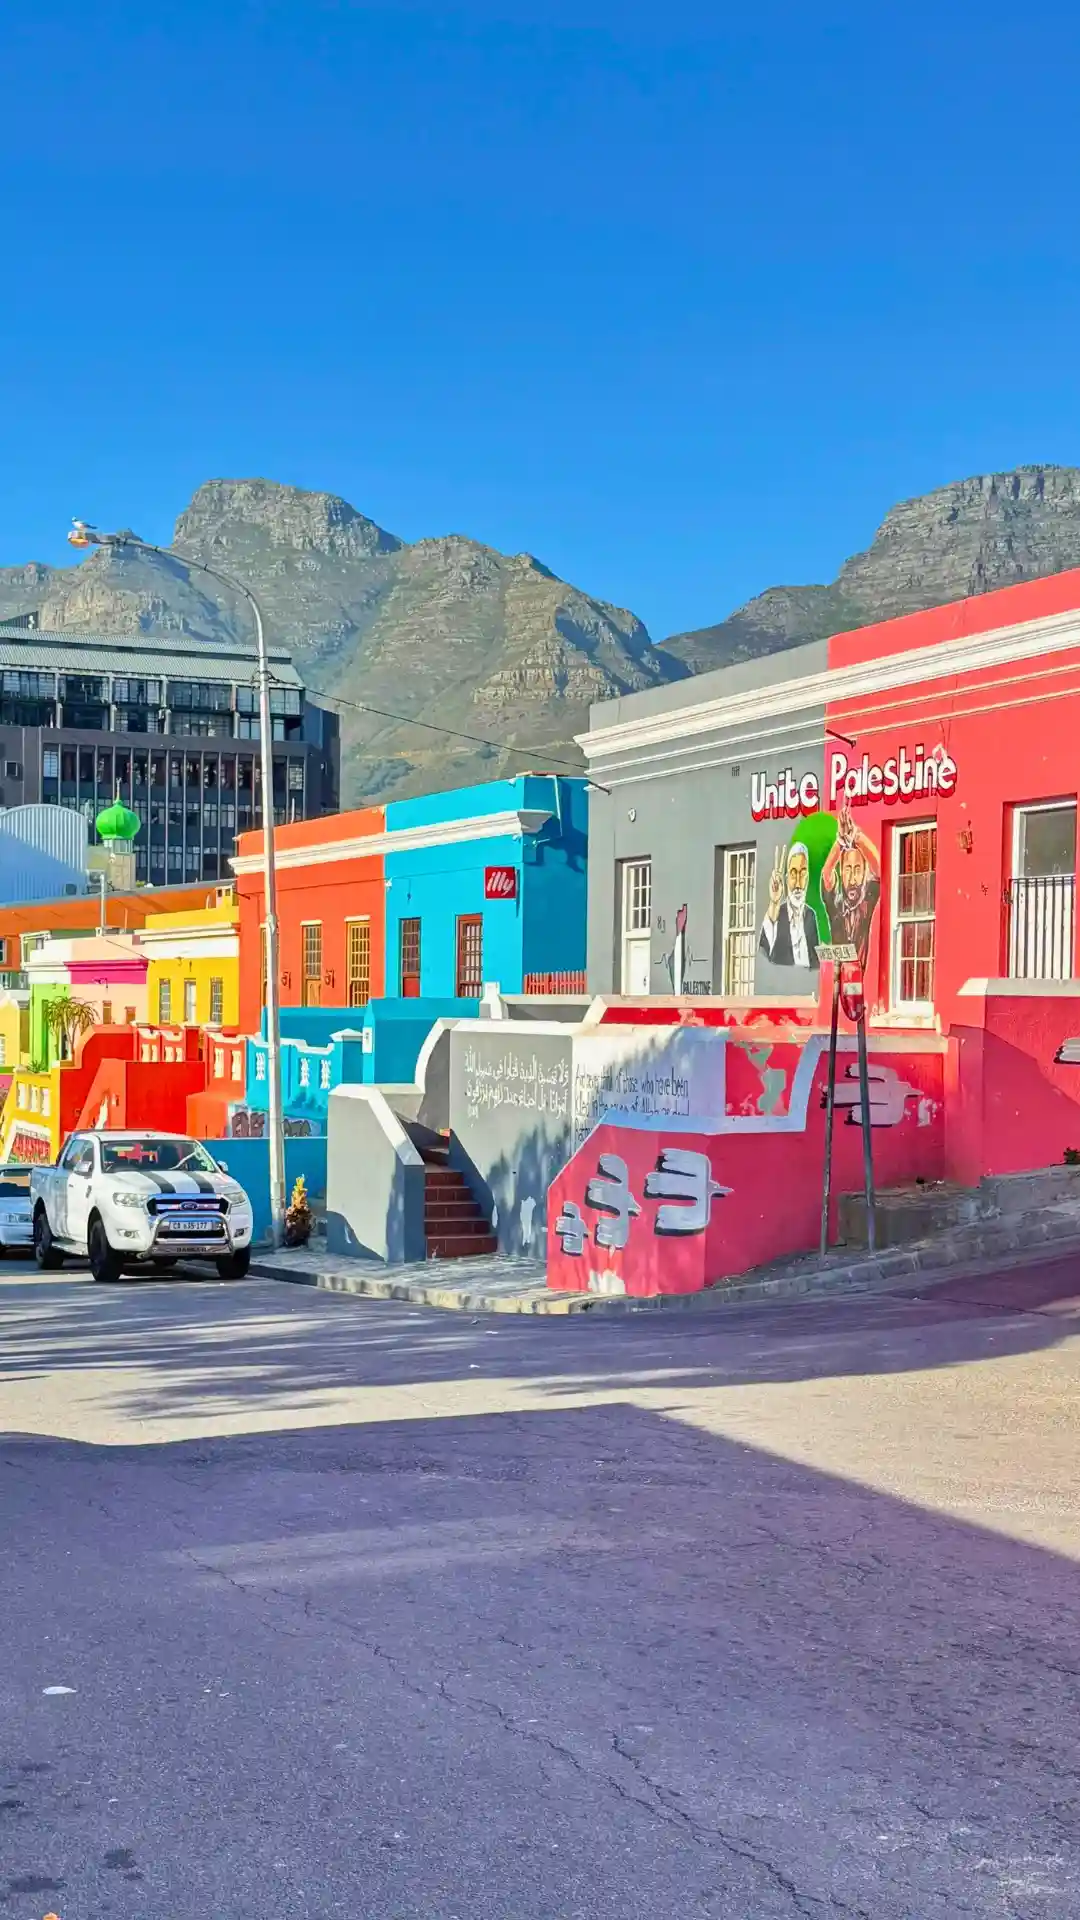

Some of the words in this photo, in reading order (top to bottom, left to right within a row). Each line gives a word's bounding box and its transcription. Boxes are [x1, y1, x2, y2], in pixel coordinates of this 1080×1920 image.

[751, 766, 819, 821] Unite
[829, 743, 957, 809] Palestine
[487, 871, 514, 896] illy
[682, 980, 711, 995] PALESTINE
[641, 1070, 654, 1095] who
[671, 1066, 689, 1098] been
